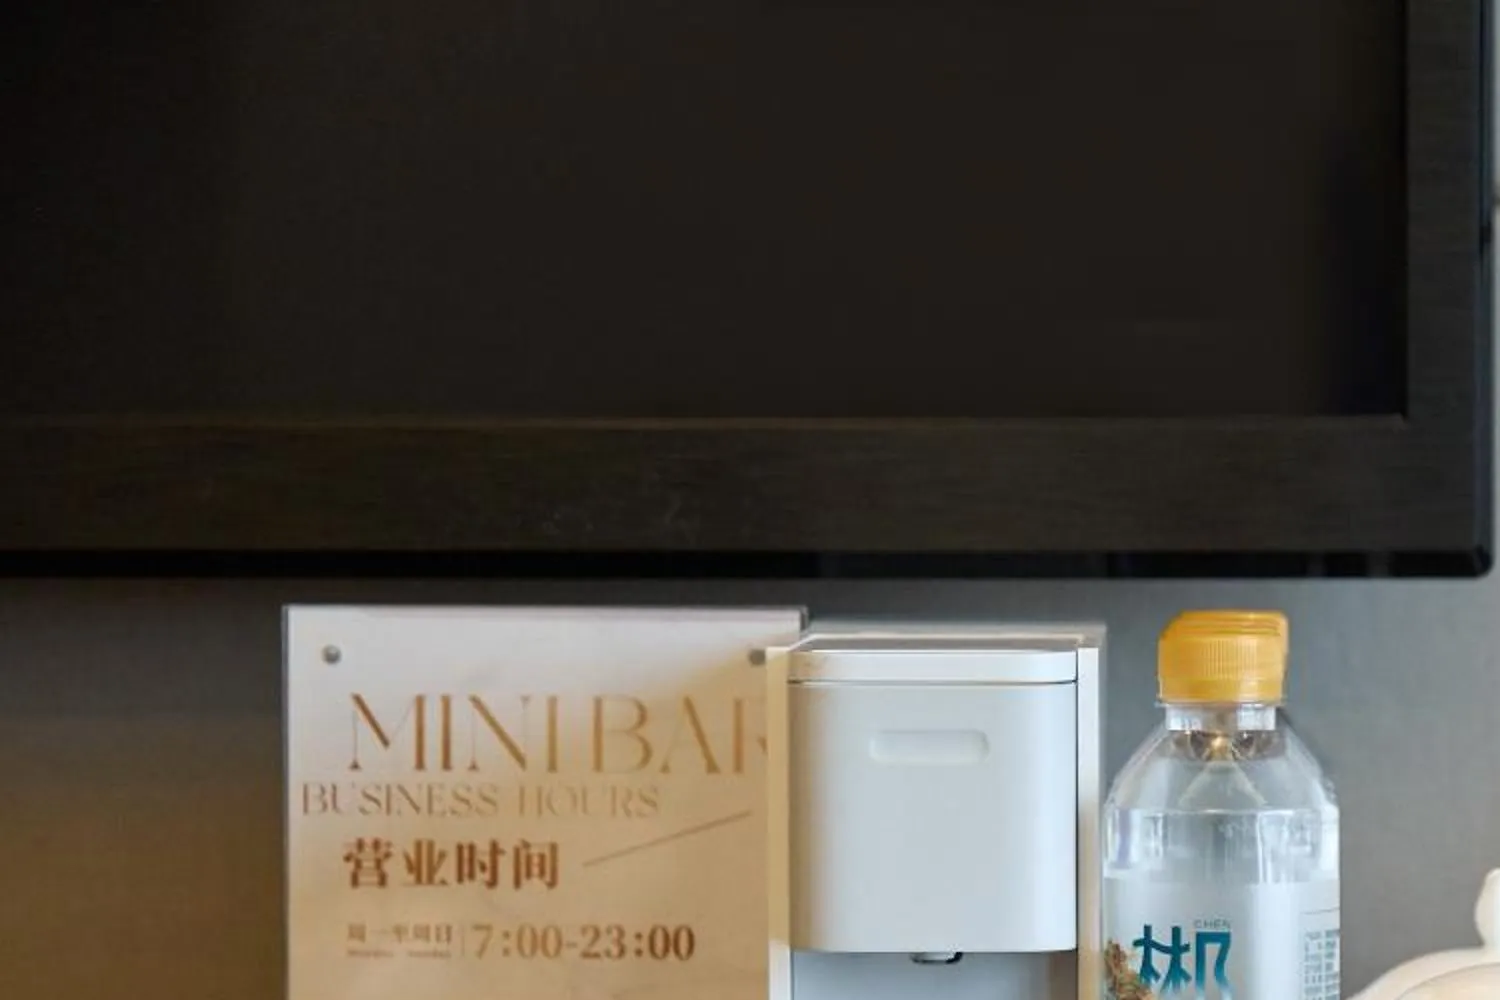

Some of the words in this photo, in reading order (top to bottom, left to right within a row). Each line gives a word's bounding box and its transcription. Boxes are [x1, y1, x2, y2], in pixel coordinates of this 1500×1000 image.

[348, 693, 562, 771] MINI
[302, 782, 499, 817] BUSINESS
[517, 785, 660, 819] HOURS
[343, 838, 560, 890] 营业时间
[471, 923, 696, 962] 7:00-23:00
